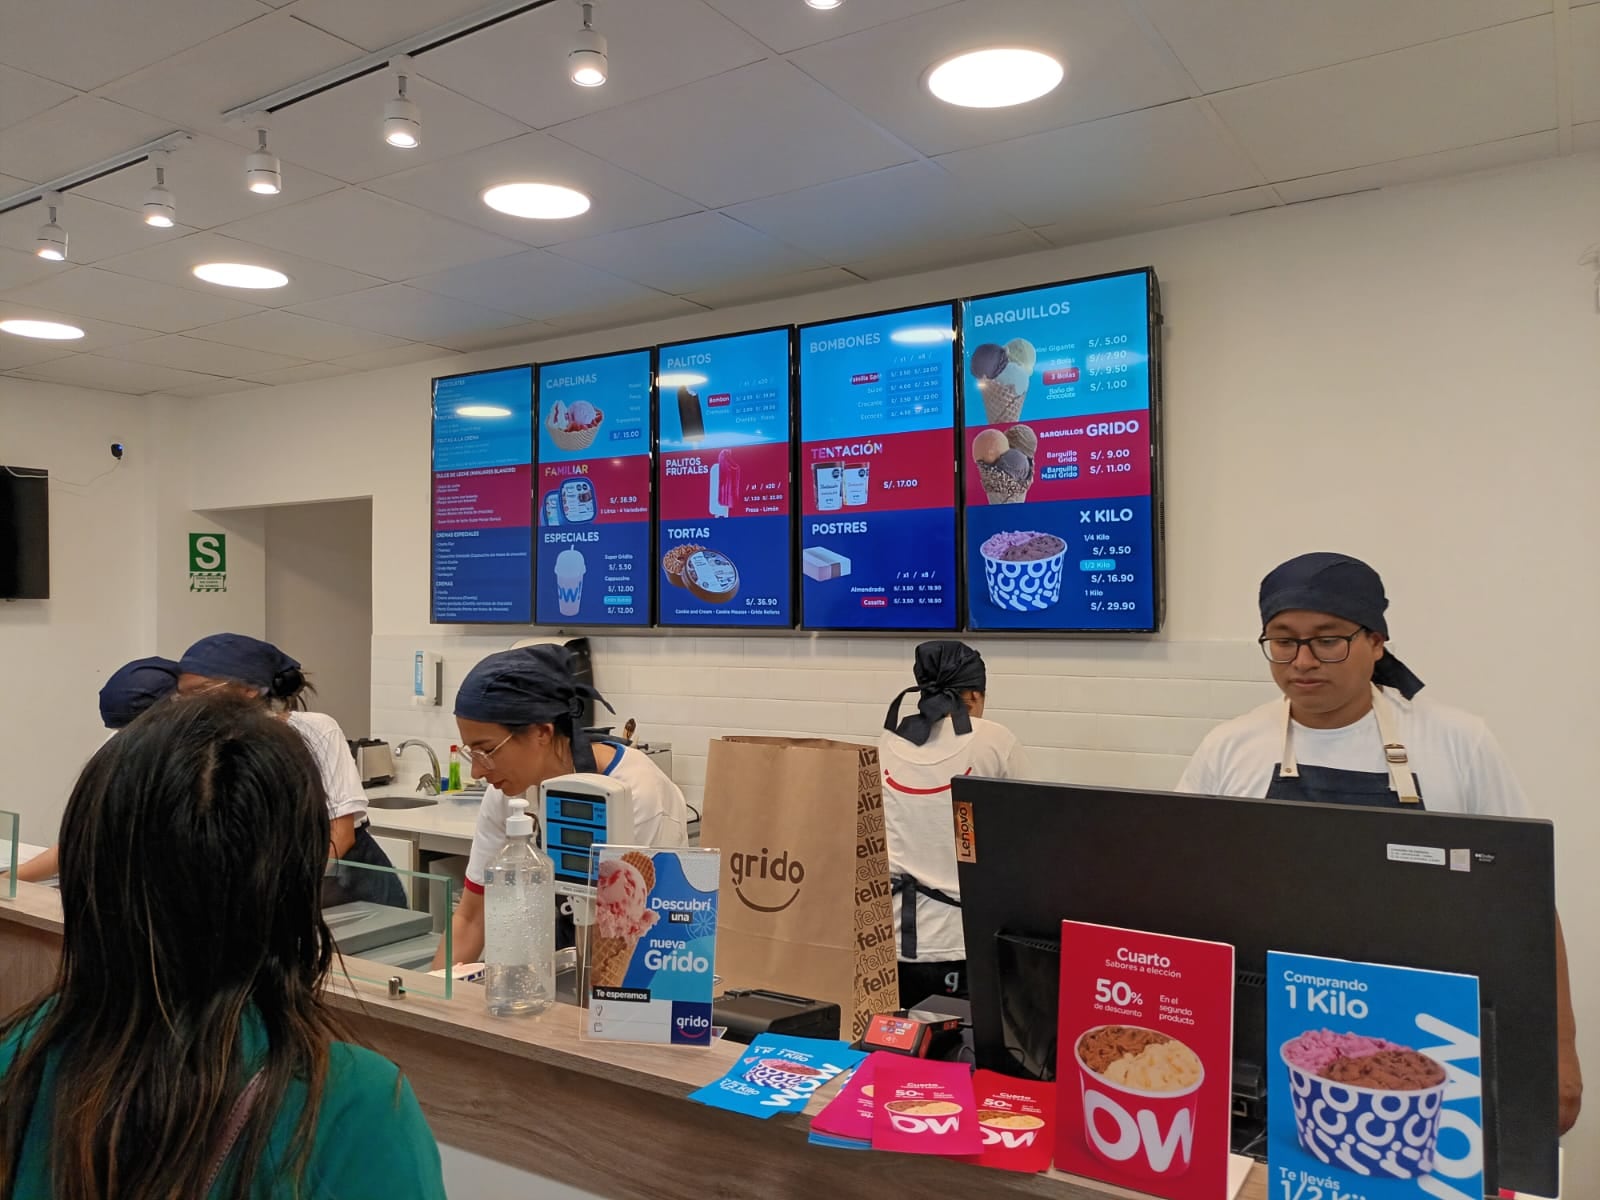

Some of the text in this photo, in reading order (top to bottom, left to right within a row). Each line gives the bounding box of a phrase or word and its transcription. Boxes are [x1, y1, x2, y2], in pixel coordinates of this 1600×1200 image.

[974, 301, 1071, 328] BARQUILLOS
[810, 332, 881, 354] BOMBONES
[1048, 335, 1128, 352] Gigante S/. 5.00
[667, 353, 712, 369] PALITOS
[1089, 353, 1103, 363] S/.
[1105, 350, 1128, 360] 7.90
[1089, 367, 1103, 376] S/.
[1105, 364, 1128, 374] 9.50
[546, 374, 597, 389] CAPELINAS
[1089, 379, 1128, 392] S/. 1.00
[623, 430, 640, 438] 15.00
[1040, 420, 1139, 439] BARQUILLOS GRIDO
[811, 440, 884, 460] TENTACIÓN
[1046, 449, 1130, 460] Barquillo S/. 9.00
[665, 457, 701, 468] PALITOS
[1047, 463, 1131, 475] Barquillo S/. 11.00
[545, 464, 589, 477] FAMILIAR
[665, 465, 709, 476] FRUTALES
[883, 479, 918, 489] S/. 17.00
[1079, 508, 1133, 523] X KILO
[667, 527, 710, 539] TORTAS
[812, 521, 867, 535] POSTRES
[544, 531, 600, 543] ESPECIALES
[195, 536, 221, 570] S
[1092, 545, 1132, 556] S/. 9.50
[1084, 561, 1095, 569] 1/2
[1091, 573, 1134, 584] S/. 16.90
[745, 598, 778, 607] S/. 36.90
[1091, 602, 1135, 611] S/. 29.90
[959, 806, 971, 858] Lenovo
[730, 847, 805, 886] grido
[651, 897, 712, 912] Descubrí
[671, 913, 690, 922] una
[855, 901, 891, 929] feliz
[650, 938, 686, 950] nueva
[857, 924, 894, 951] feliz
[644, 950, 709, 974] Grido
[860, 945, 895, 974] feliz
[1116, 947, 1171, 969] Cuarto
[1105, 960, 1139, 973] Sabores
[1146, 965, 1182, 979] elección
[862, 968, 896, 995] feliz
[1283, 970, 1368, 992] Comprando
[595, 989, 648, 1000] Te esperamos
[1095, 978, 1144, 1006] 50%
[1159, 995, 1178, 1005] En el
[1285, 984, 1369, 1019] 1 Kilo
[1094, 1002, 1143, 1018] de descuento
[1159, 1003, 1193, 1017] segundo
[676, 1014, 709, 1029] grido
[1159, 1012, 1195, 1026] producto
[1280, 1167, 1340, 1191] Te llevás
